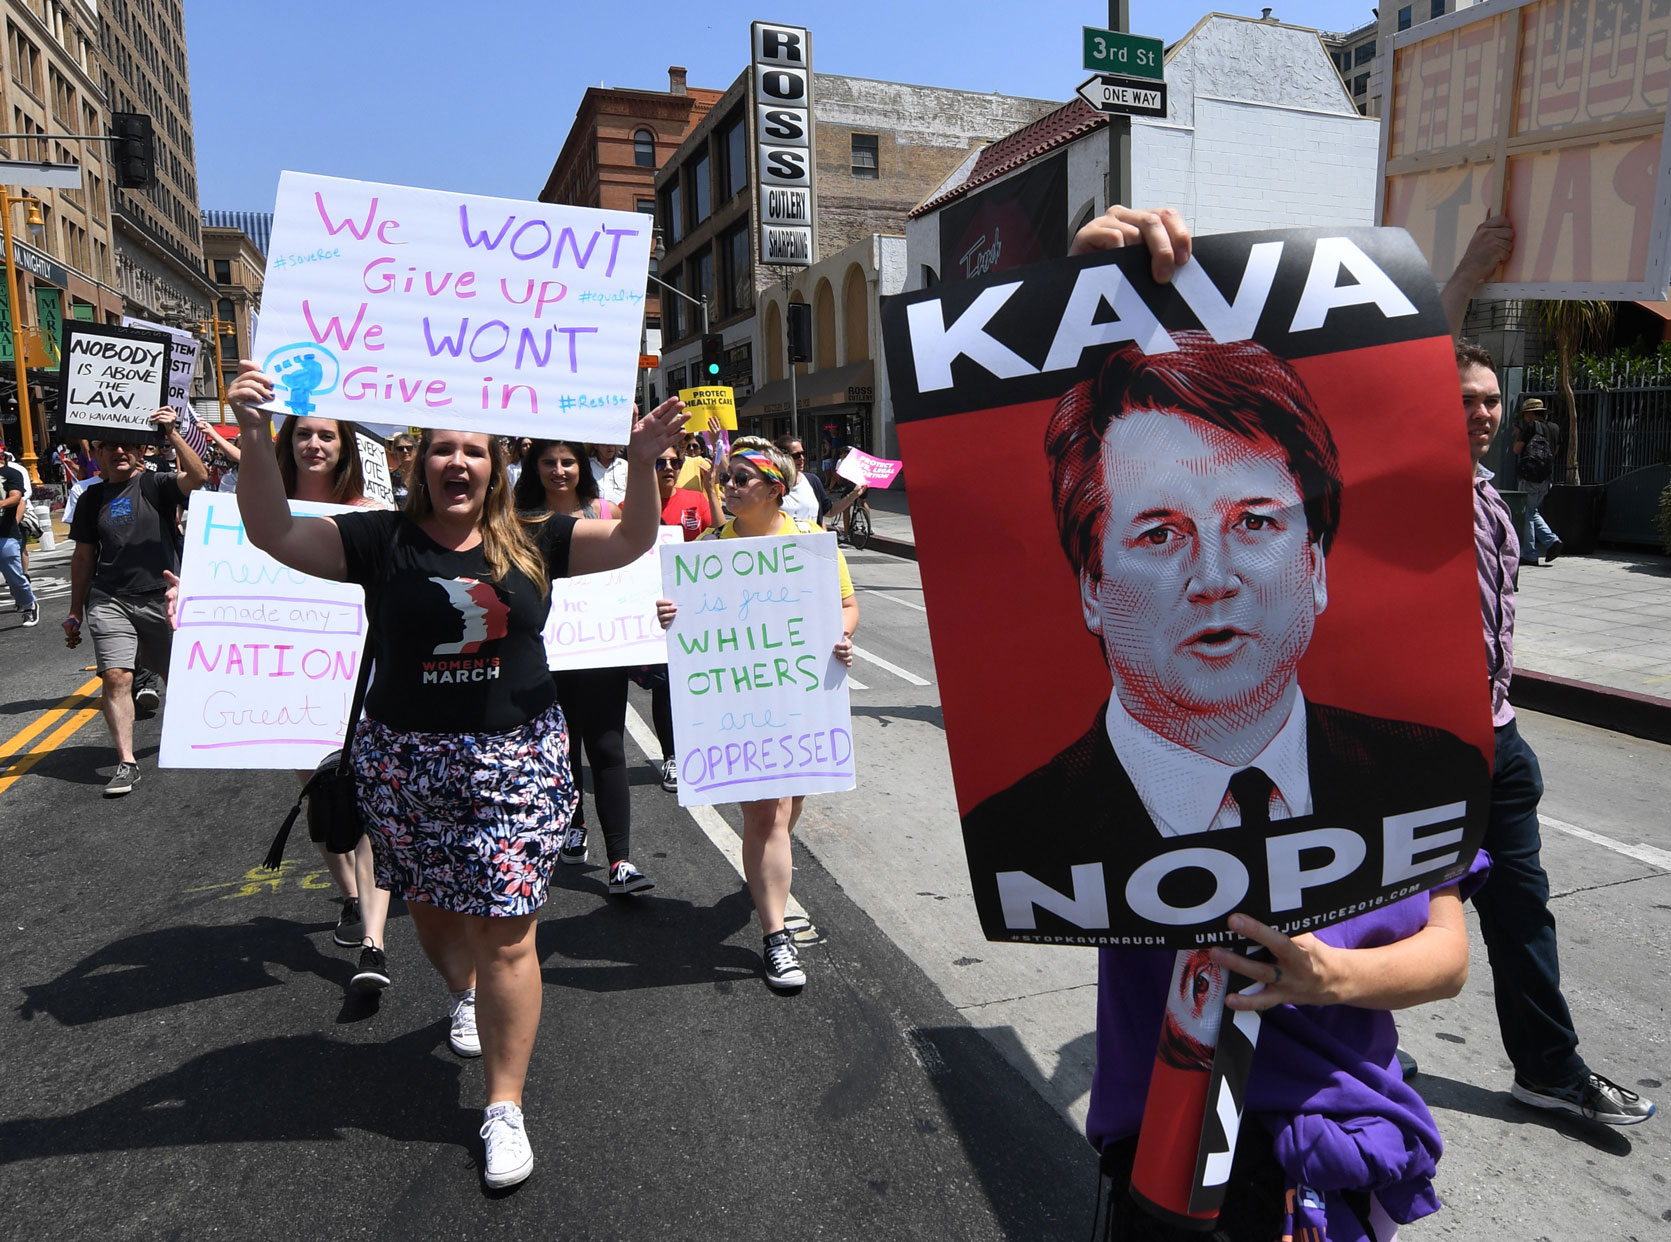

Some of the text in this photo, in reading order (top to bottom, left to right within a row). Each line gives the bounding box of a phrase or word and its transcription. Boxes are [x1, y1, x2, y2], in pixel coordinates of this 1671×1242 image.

[1093, 37, 1155, 67] 3rd St
[762, 28, 805, 179] ROSS
[1103, 87, 1158, 107] ONE WAY
[768, 190, 806, 220] CUTLERY
[315, 191, 639, 278] We WON'T
[768, 229, 808, 260] SHARPENING
[24, 250, 51, 279] NIGHTLY
[363, 257, 477, 299] Give
[578, 289, 643, 307] #equality
[906, 236, 1420, 393] KAVA
[302, 300, 598, 373] We WON'T
[70, 339, 162, 368] NOBODY
[77, 363, 158, 384] IS ABOVE
[95, 380, 130, 392] THE
[342, 366, 538, 415] Give in
[559, 394, 628, 413] #Resist
[684, 398, 716, 408] HEALTH
[692, 390, 727, 398] PROTECT
[848, 386, 873, 395] ROSS
[70, 411, 86, 419] NO
[675, 543, 804, 586] NO ONE
[213, 603, 330, 632] made any
[695, 593, 728, 615] is
[677, 617, 806, 654] WHILE
[187, 640, 357, 680] NATION
[422, 657, 500, 671] WOMEN'S
[688, 654, 819, 695] OTHERS
[423, 666, 500, 684] MARCH
[720, 709, 786, 731] are
[682, 727, 852, 785] OPPRESSED
[996, 800, 1466, 930] NOPE
[1012, 935, 1165, 945] #STOPKAVANAUGH
